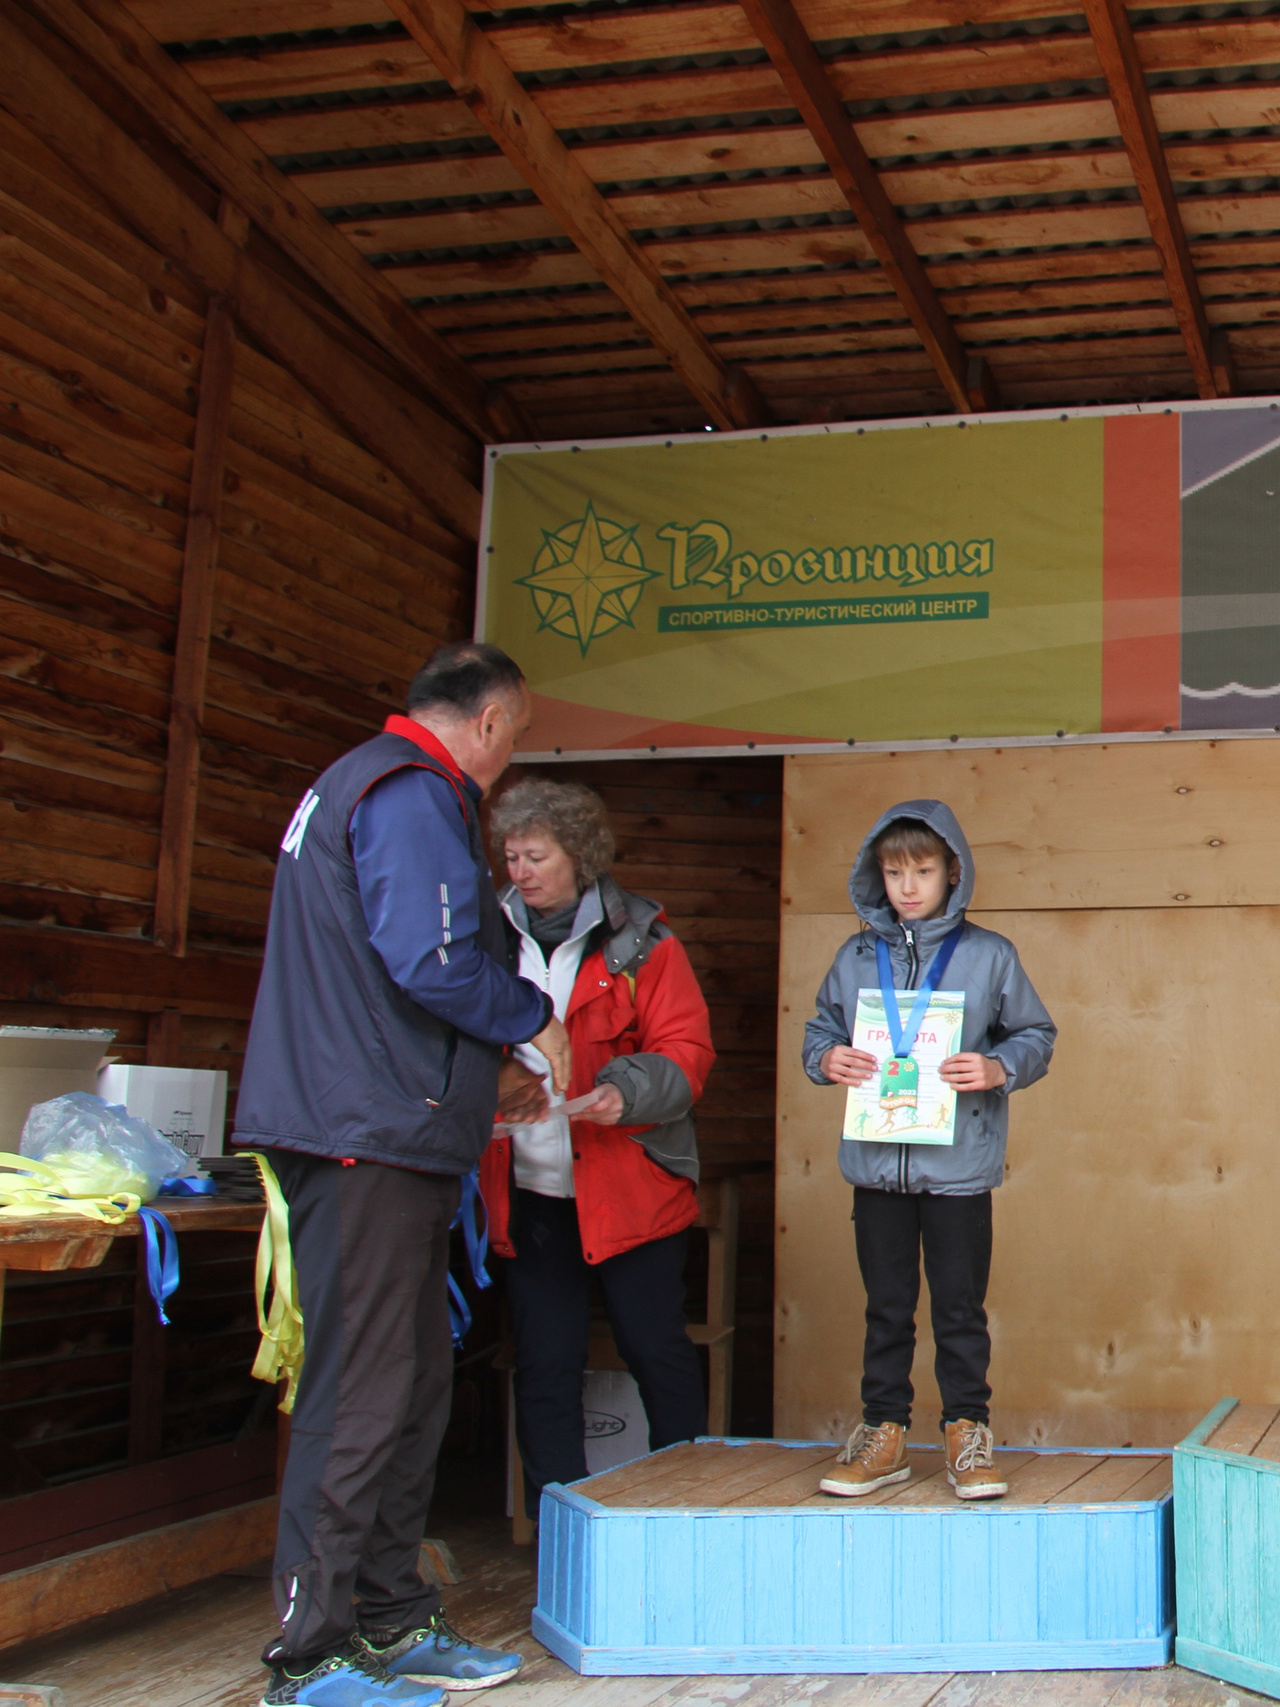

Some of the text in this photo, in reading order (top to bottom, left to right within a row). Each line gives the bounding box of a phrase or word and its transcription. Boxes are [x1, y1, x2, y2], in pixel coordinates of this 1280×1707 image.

[655, 519, 994, 600] Провинция
[669, 599, 978, 626] СПОРТИВНО-ТУРИСТИЧЕСКИЙ ЦЕНТР
[887, 1061, 899, 1076] 2
